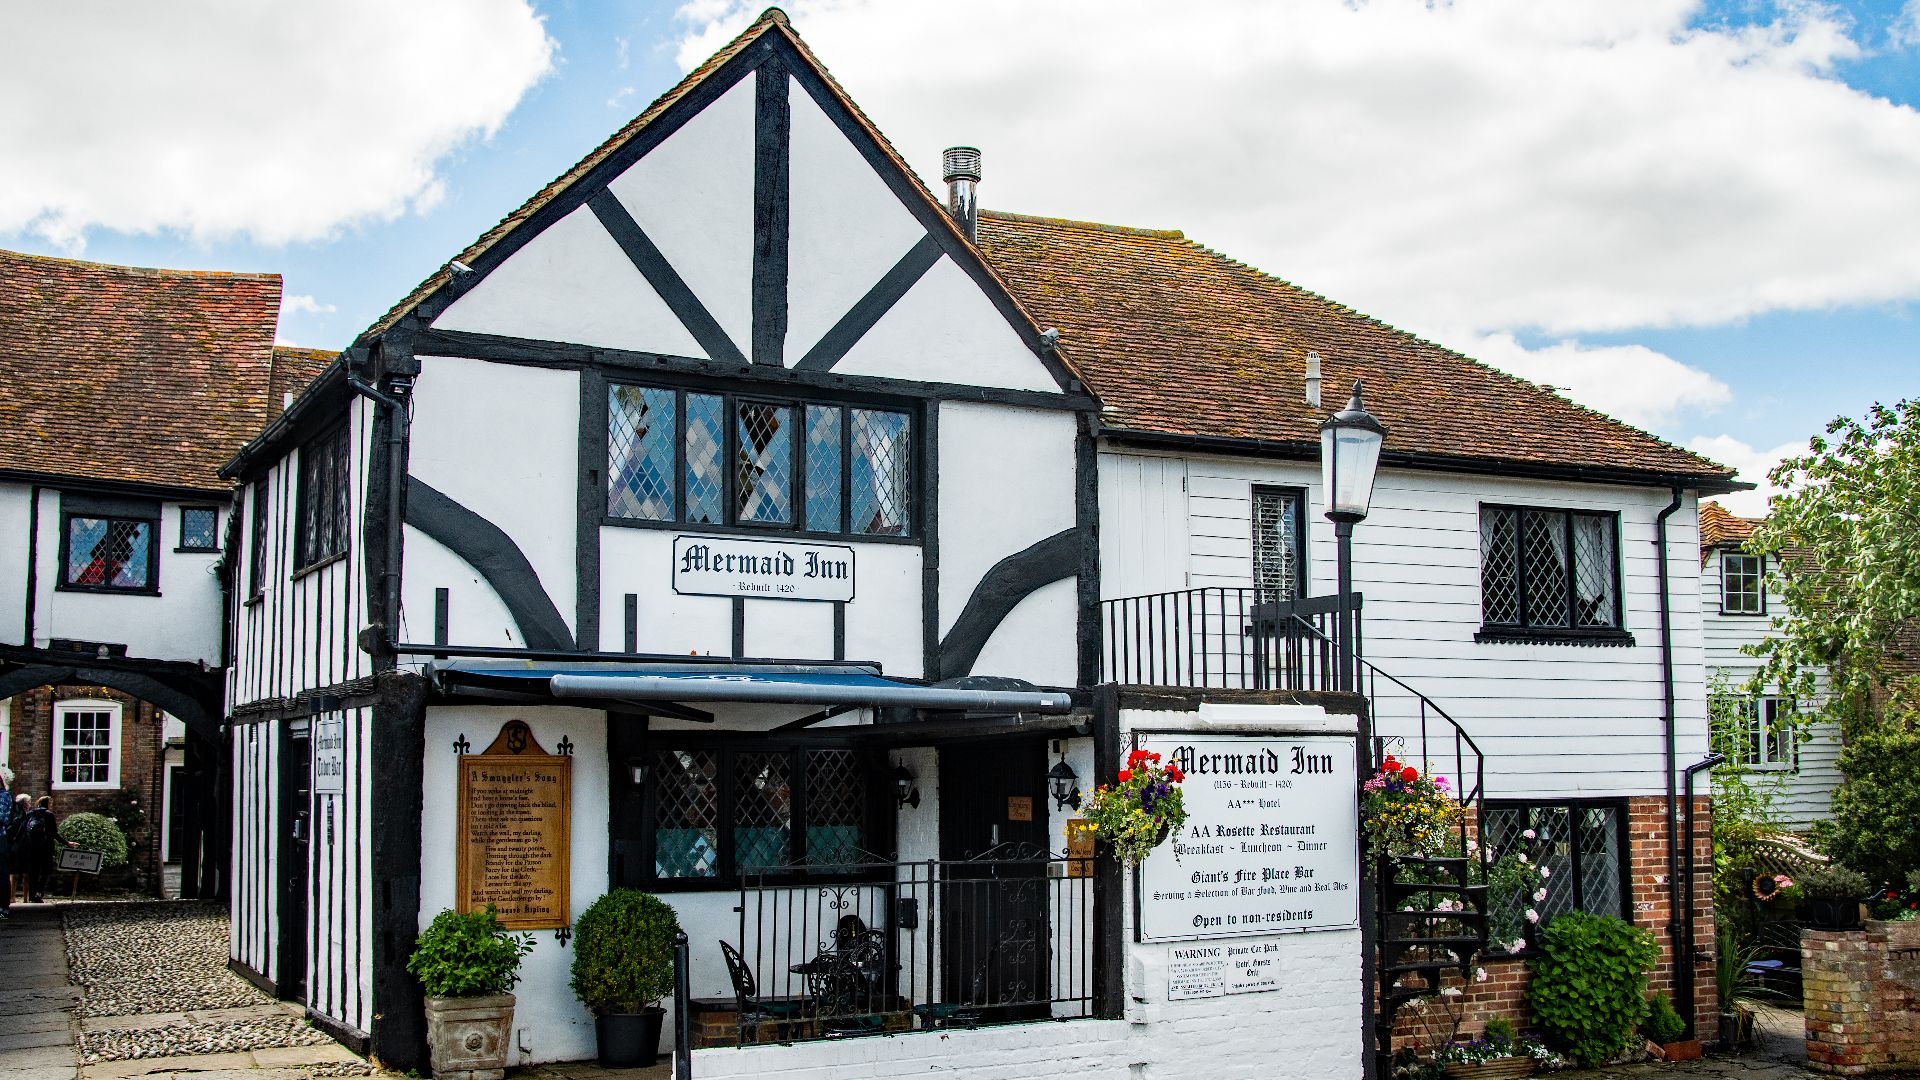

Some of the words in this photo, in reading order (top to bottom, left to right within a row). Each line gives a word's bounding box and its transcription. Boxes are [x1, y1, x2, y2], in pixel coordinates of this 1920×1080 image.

[681, 544, 794, 577] Mermaid
[803, 551, 848, 579] Inn
[738, 582, 771, 592] Rebuilt
[776, 584, 795, 593] 1420
[1169, 745, 1278, 775] Mermaid
[1291, 746, 1333, 775] Inn
[472, 771, 478, 782] A
[535, 771, 557, 783] Song
[1240, 780, 1267, 789] Rebuilt
[1275, 780, 1293, 789] 1420)
[1258, 798, 1281, 809] Hotel
[1191, 825, 1210, 838] AA
[1216, 825, 1255, 837] Rosette
[1260, 823, 1315, 836] Restaurant
[1176, 843, 1224, 855] Breakfast
[1240, 842, 1282, 854] Luncheon
[1297, 840, 1327, 852] Dinner
[1191, 870, 1229, 884] Giant's
[1233, 869, 1257, 884] Fire
[1262, 868, 1289, 883] Place
[1294, 866, 1314, 879] Bar
[1153, 890, 1185, 901] Serving
[1194, 889, 1229, 899] Selection
[1231, 887, 1239, 897] of
[1240, 886, 1254, 896] Bar
[1299, 884, 1312, 893] and
[1314, 883, 1330, 892] Real
[1332, 881, 1349, 891] Ales
[1192, 914, 1222, 928] Open
[1227, 914, 1237, 925] to
[1242, 909, 1313, 924] non-residents
[1174, 947, 1221, 960] WARNING
